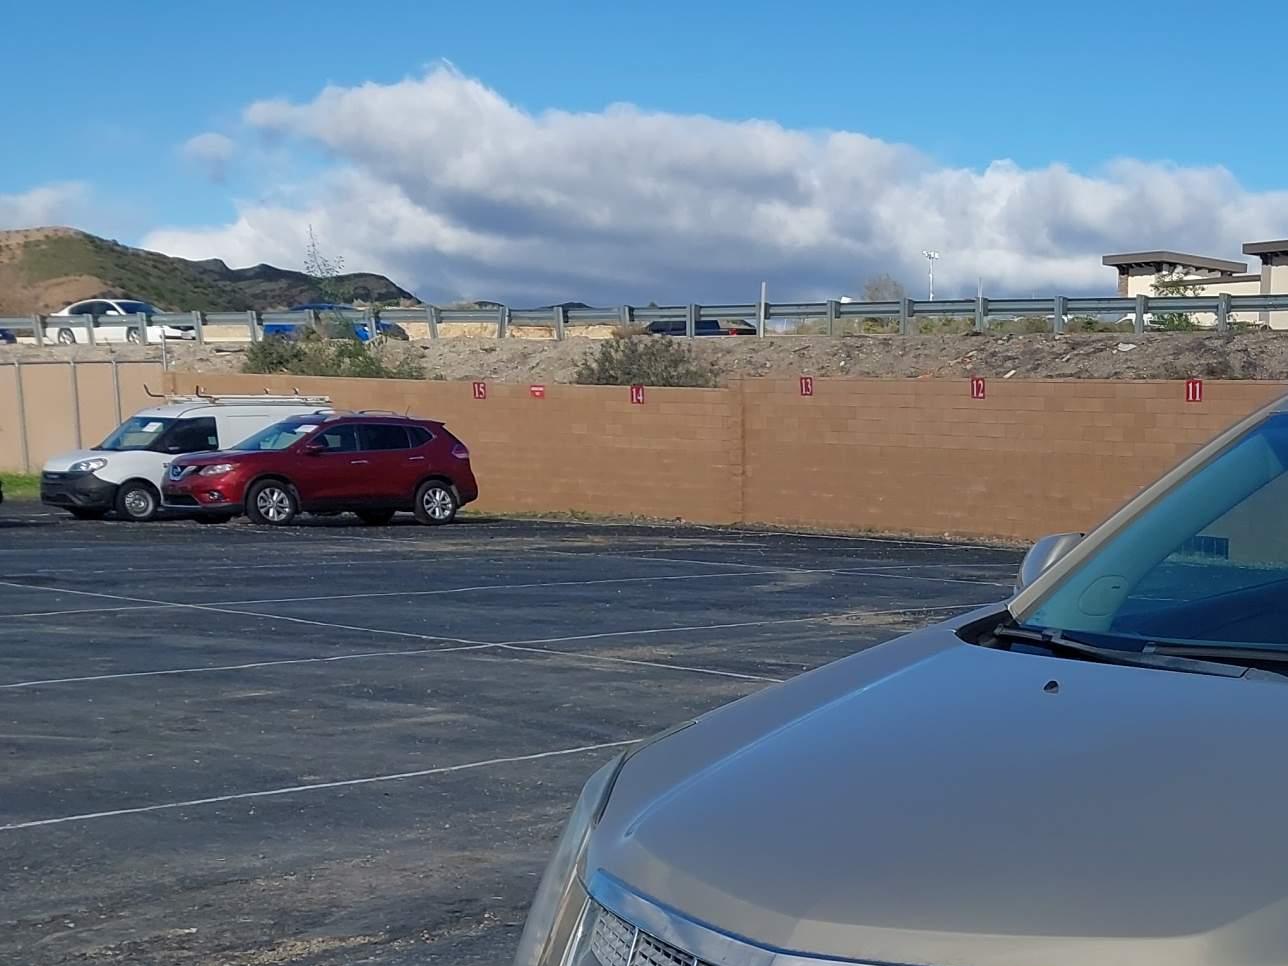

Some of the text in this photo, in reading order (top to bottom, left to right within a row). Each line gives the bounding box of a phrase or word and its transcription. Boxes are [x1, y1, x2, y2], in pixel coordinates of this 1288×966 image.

[474, 383, 485, 398] 15
[802, 379, 811, 394] 13
[973, 380, 984, 397] 12
[1188, 382, 1201, 400] 11
[632, 388, 643, 402] 14
